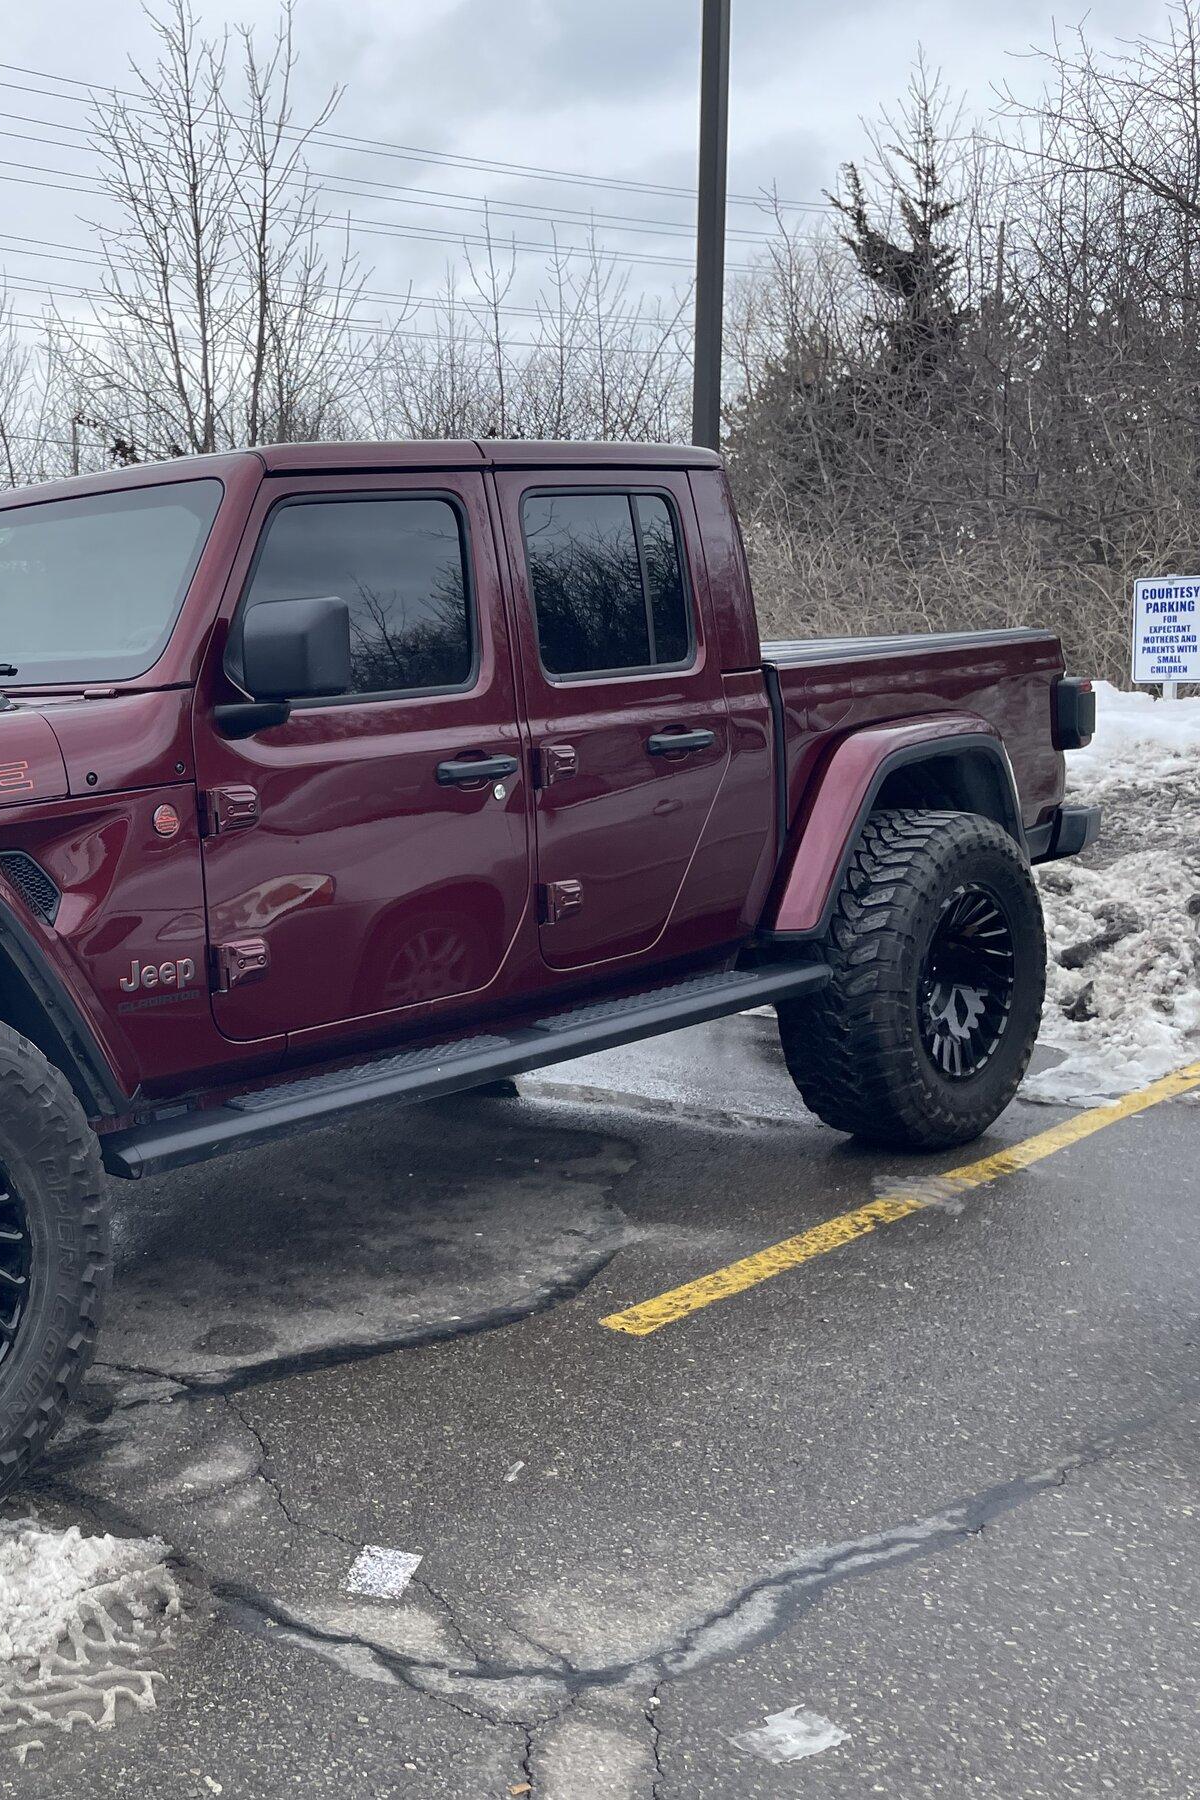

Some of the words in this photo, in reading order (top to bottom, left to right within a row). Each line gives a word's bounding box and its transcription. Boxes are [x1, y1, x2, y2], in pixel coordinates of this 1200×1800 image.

[1142, 586, 1200, 600] COURTESY
[1146, 600, 1195, 614] PARKING
[1163, 615, 1178, 624] FOR
[1149, 624, 1191, 634] EXPECTANT
[1143, 635, 1179, 644] MOTHERS
[1181, 634, 1197, 643] AND
[1142, 645, 1175, 654] PARENTS
[1177, 644, 1198, 653] WITH
[1157, 655, 1182, 664] SMALL
[1150, 665, 1188, 674] CHILDREN
[120, 957, 196, 992] Jeep
